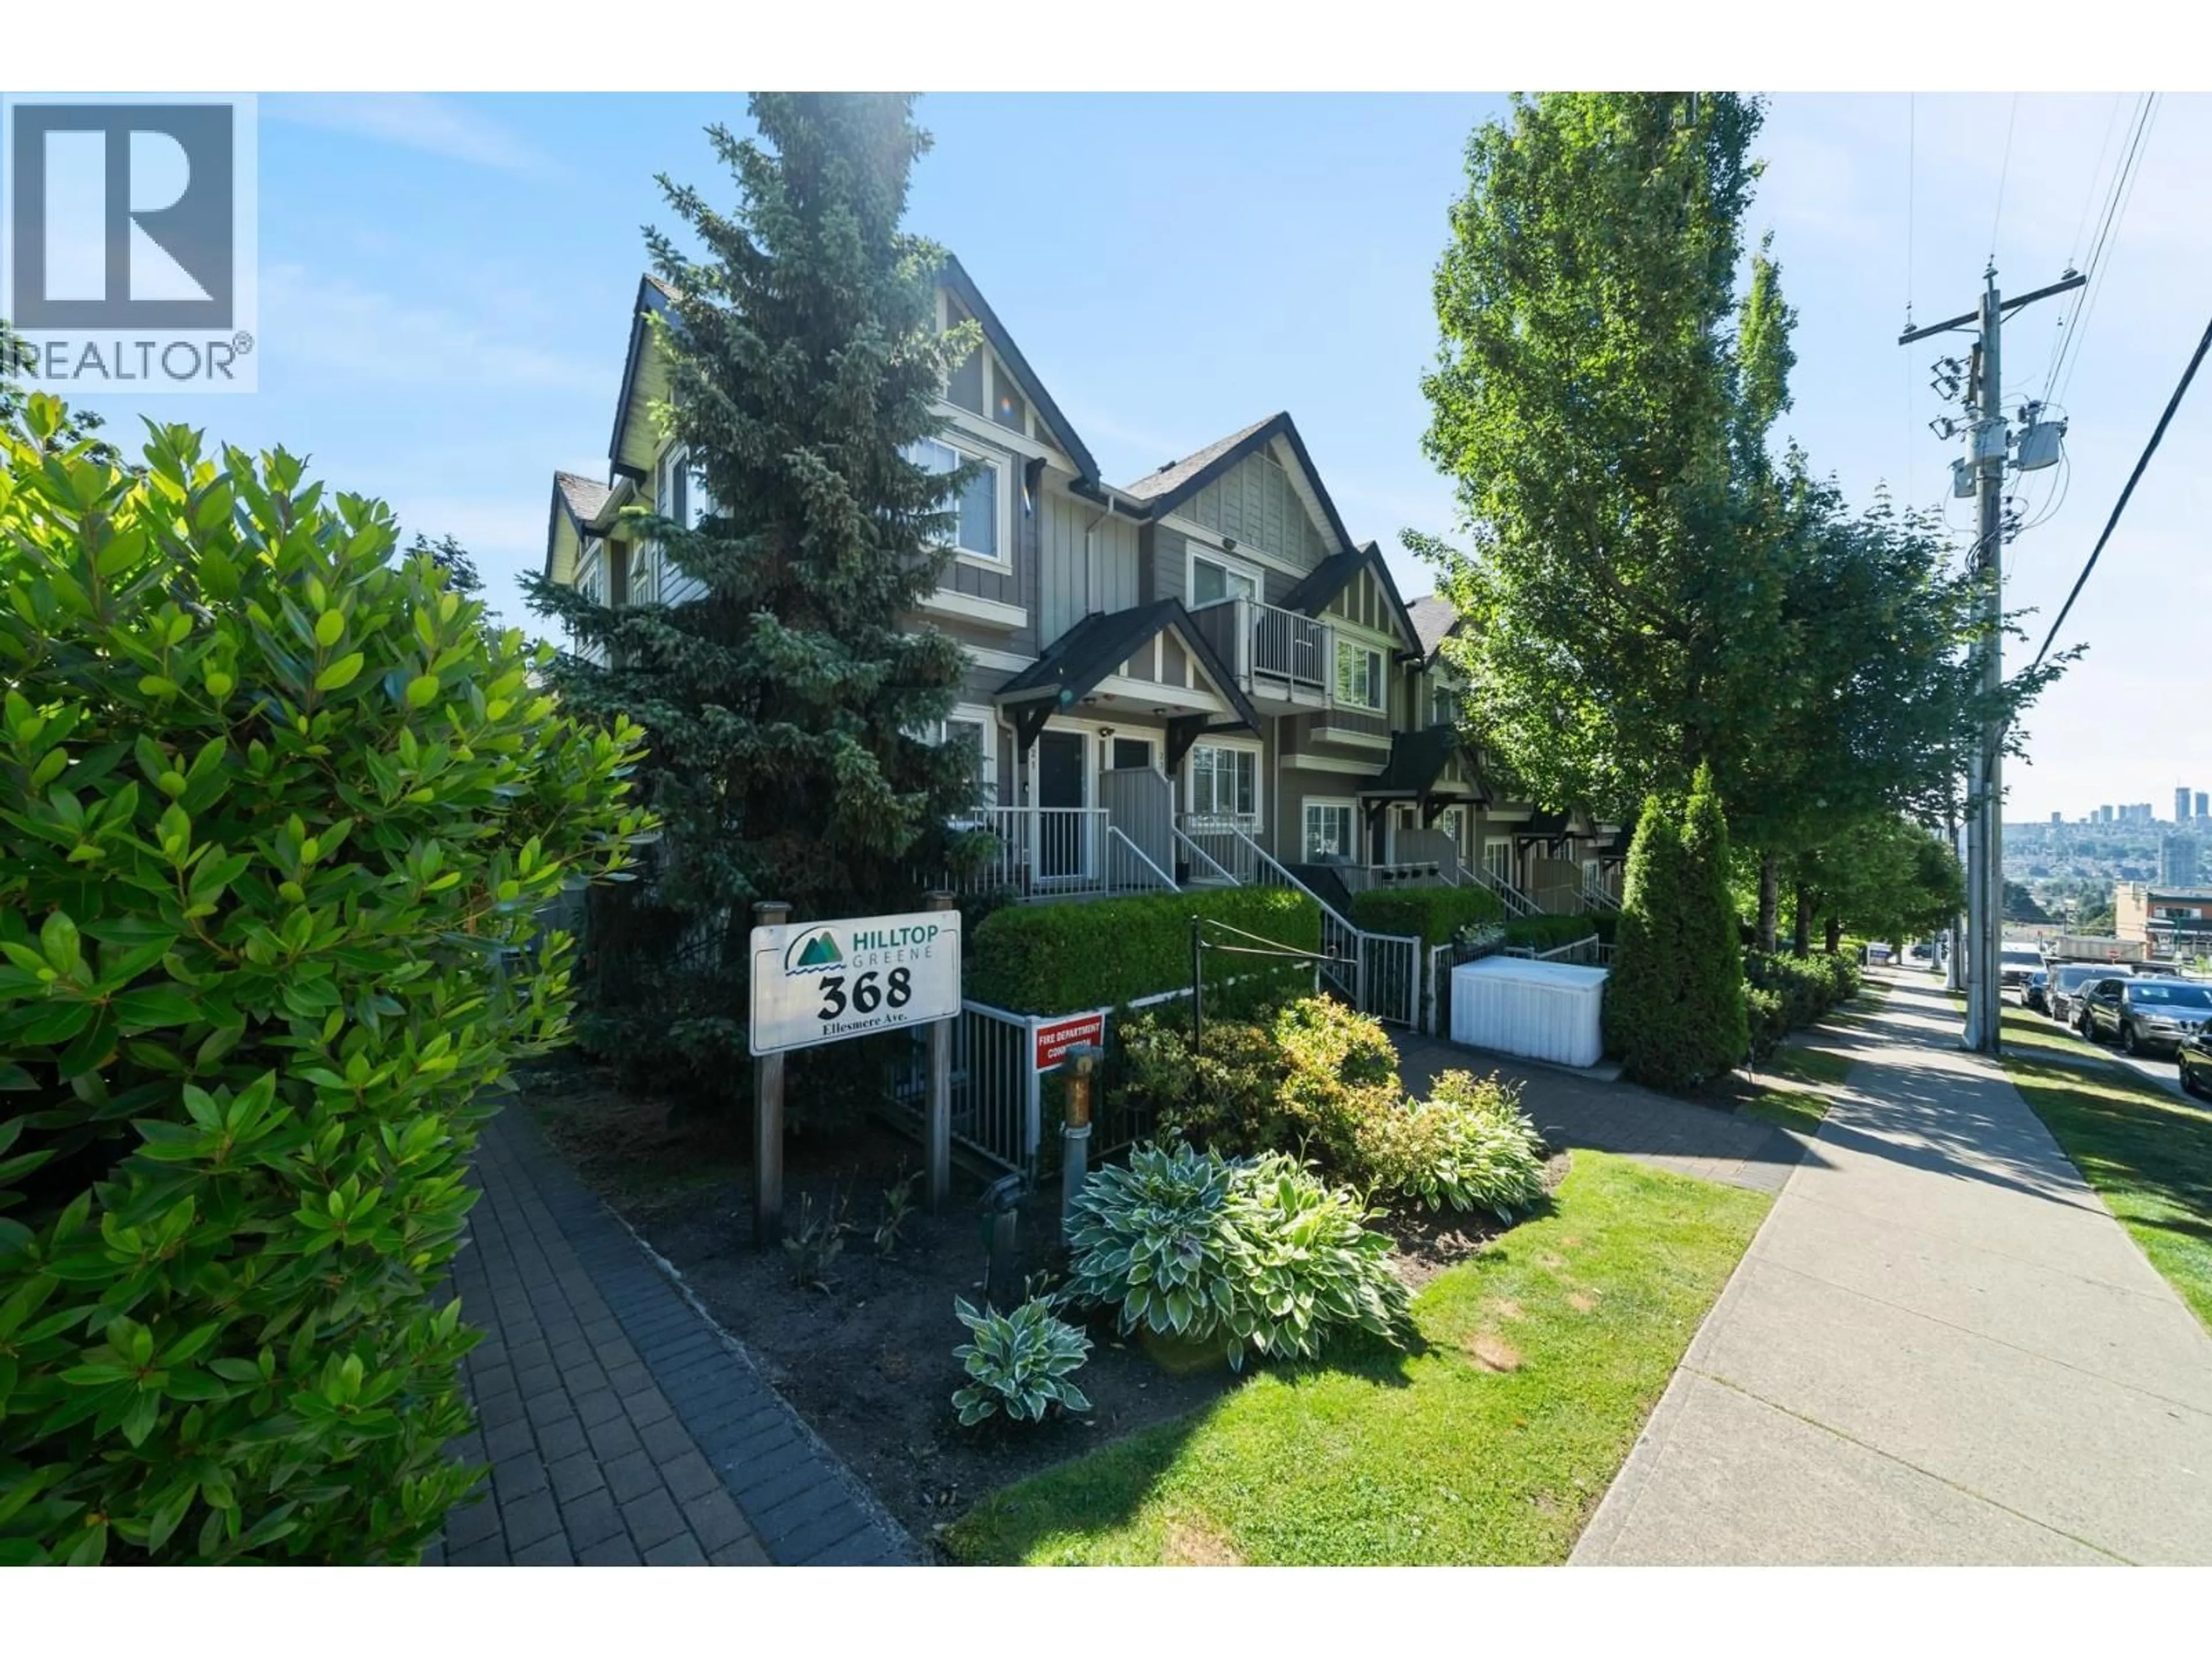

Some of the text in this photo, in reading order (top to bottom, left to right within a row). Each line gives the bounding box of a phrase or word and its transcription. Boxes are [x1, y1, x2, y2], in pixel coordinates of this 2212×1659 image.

[853, 925, 938, 952] HILLTOP
[853, 946, 933, 968] GREENE
[817, 967, 912, 1020] 368
[822, 1013, 908, 1036] Ellesmere Ave.
[1039, 1021, 1101, 1046] FIRE DEPARTMENT
